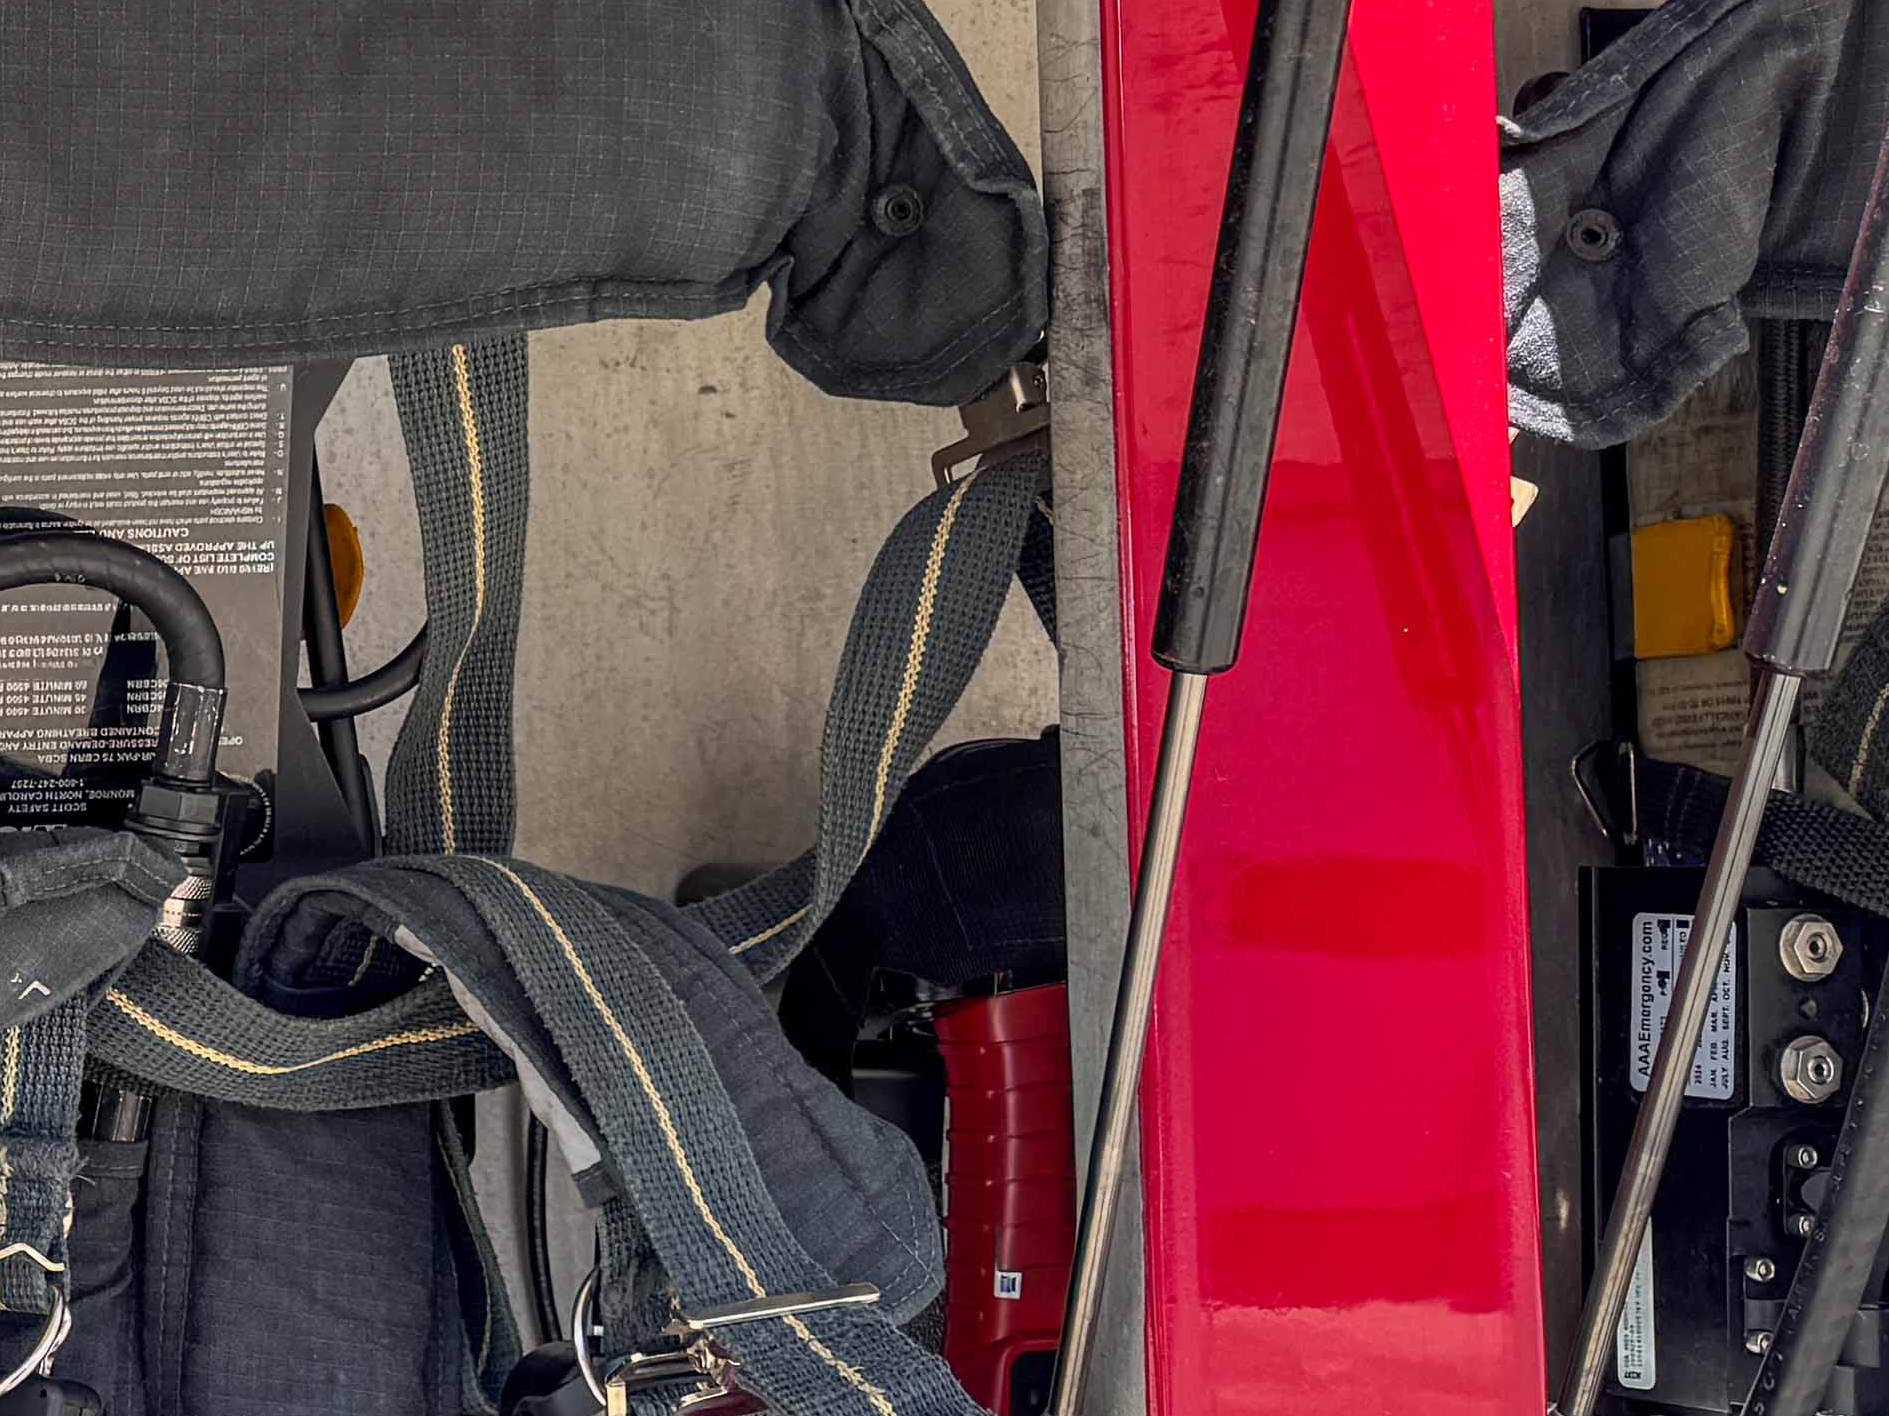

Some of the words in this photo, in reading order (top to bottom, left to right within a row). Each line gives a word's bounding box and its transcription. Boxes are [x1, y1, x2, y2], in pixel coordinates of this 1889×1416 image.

[128, 528, 189, 538] CAUTIONS
[175, 542, 234, 552] APPROVED
[237, 542, 256, 551] THE
[259, 541, 273, 550] UP
[175, 554, 191, 563] OF
[193, 553, 215, 563] LIST
[217, 552, 274, 563] COMPLETE
[32, 682, 72, 691] MINUTE
[32, 694, 72, 703] MINUTE
[32, 706, 71, 715] MINUTE
[22, 741, 57, 750] ENTRY
[45, 791, 82, 800] NORTH
[8, 804, 49, 813] SAFETY
[51, 802, 87, 812] SCOTT
